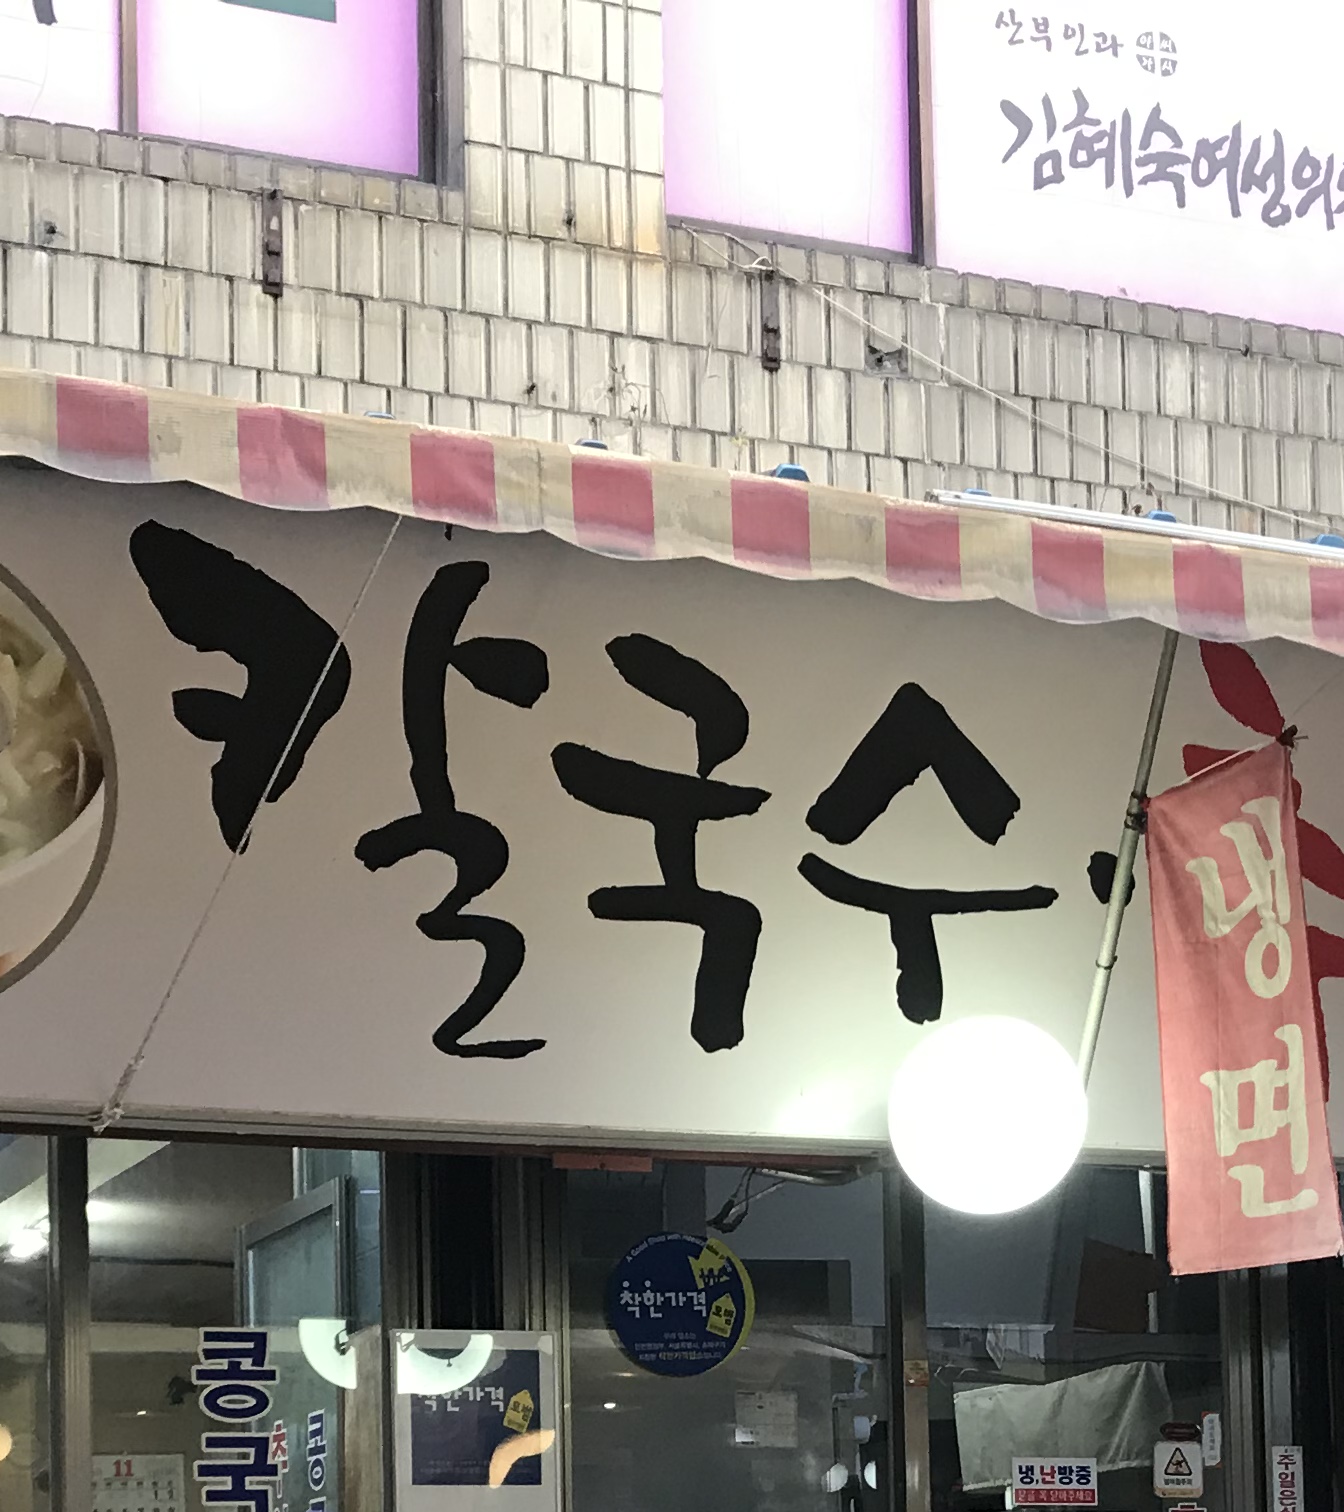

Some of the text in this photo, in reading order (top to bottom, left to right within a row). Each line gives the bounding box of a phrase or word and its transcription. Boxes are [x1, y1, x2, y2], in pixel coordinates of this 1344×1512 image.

[995, 8, 1124, 58] 산부인과
[128, 518, 1058, 1059] 칼국수
[1186, 796, 1318, 1219] 냉면
[619, 1280, 707, 1319] 착한가격
[112, 1459, 135, 1477] 11
[1018, 1465, 1092, 1486] 냉,난방중
